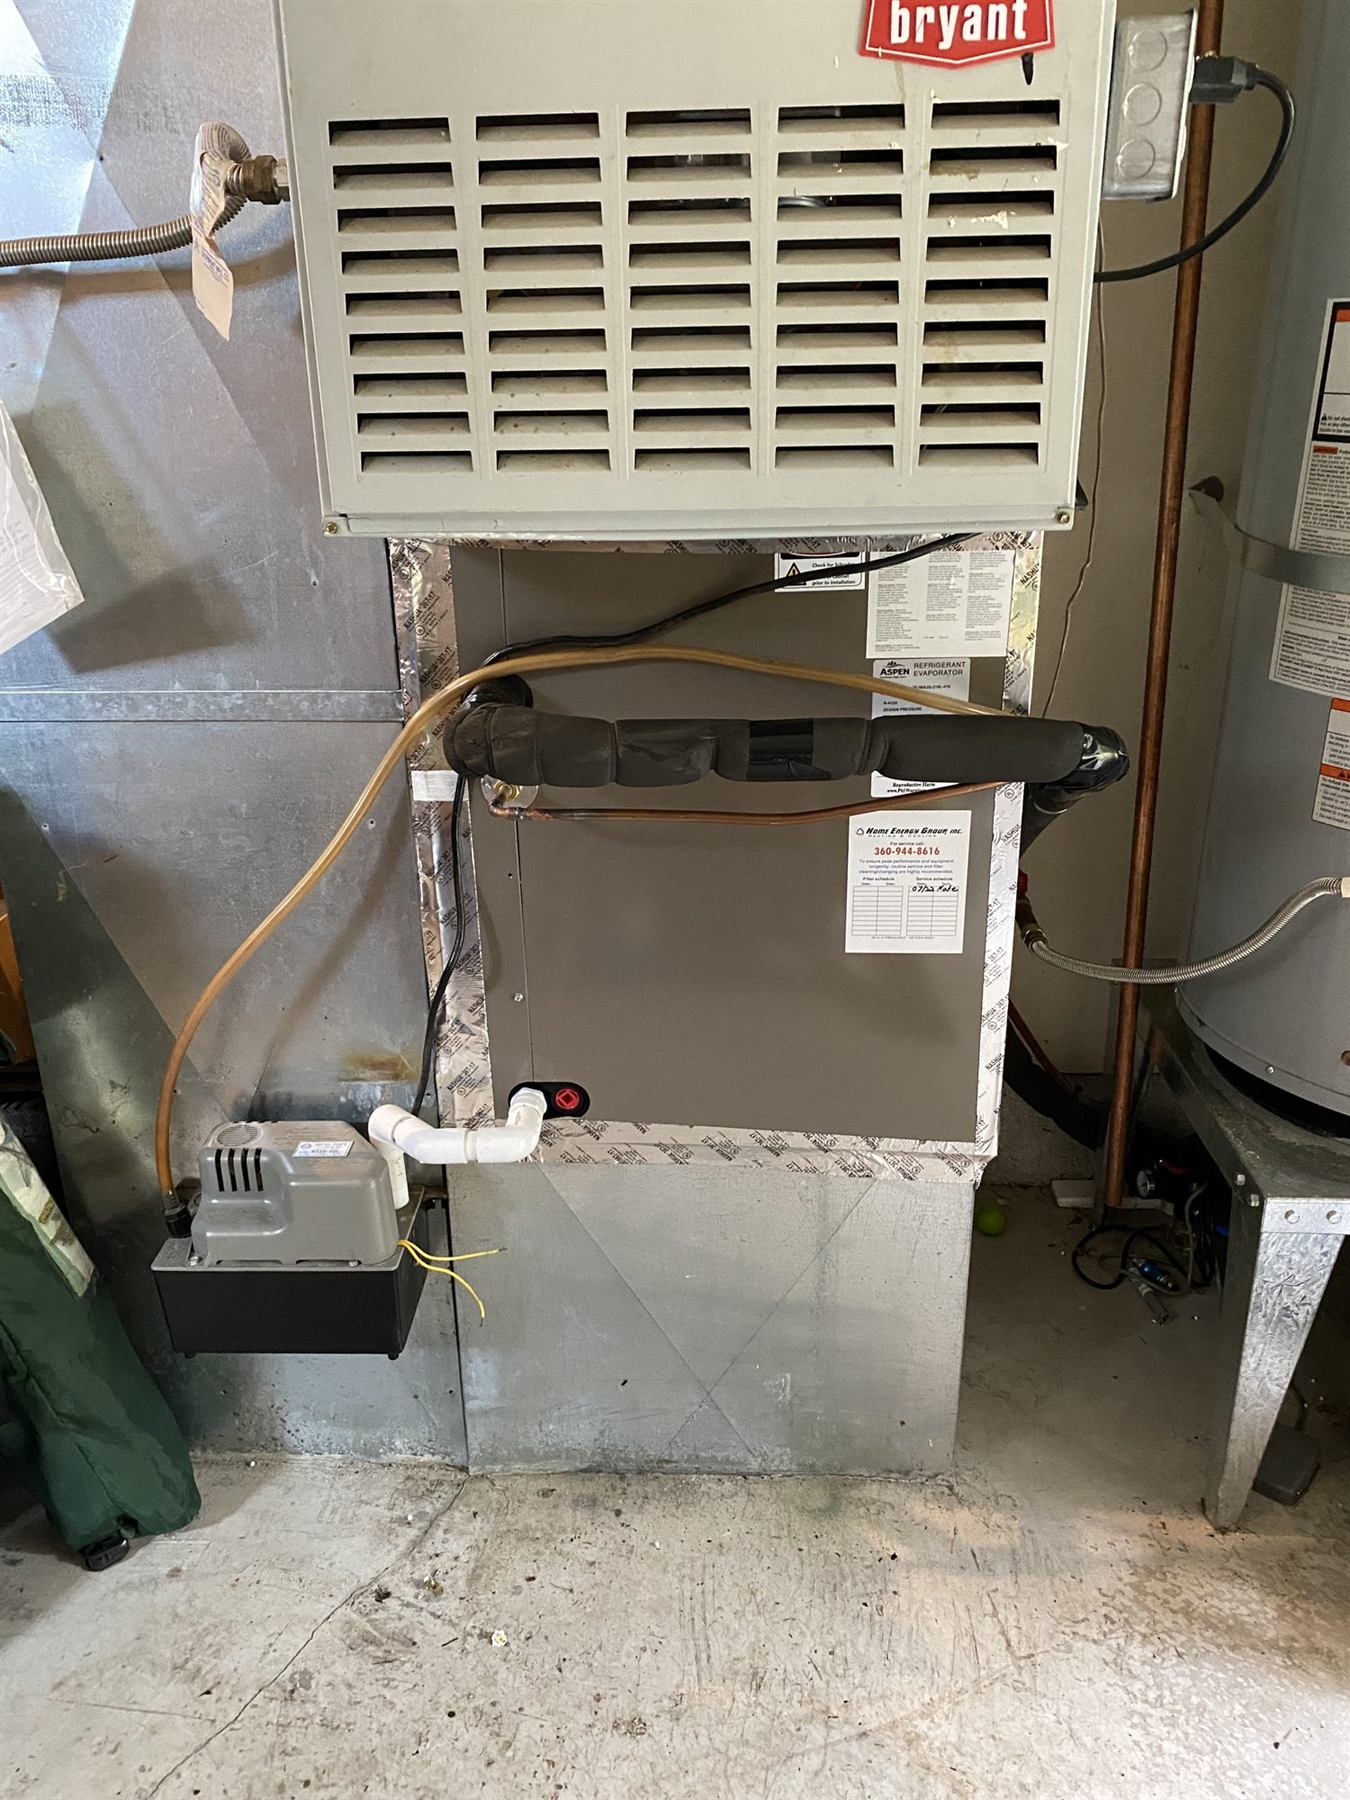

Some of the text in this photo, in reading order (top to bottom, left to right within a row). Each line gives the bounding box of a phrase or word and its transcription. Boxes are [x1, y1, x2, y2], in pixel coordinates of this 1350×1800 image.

[890, 0, 1027, 50] bryant
[913, 661, 966, 669] REFRIGERANT
[880, 668, 910, 676] ASPEN
[913, 669, 963, 677] EVAPORATOR
[874, 847, 940, 856] 360-944-8616
